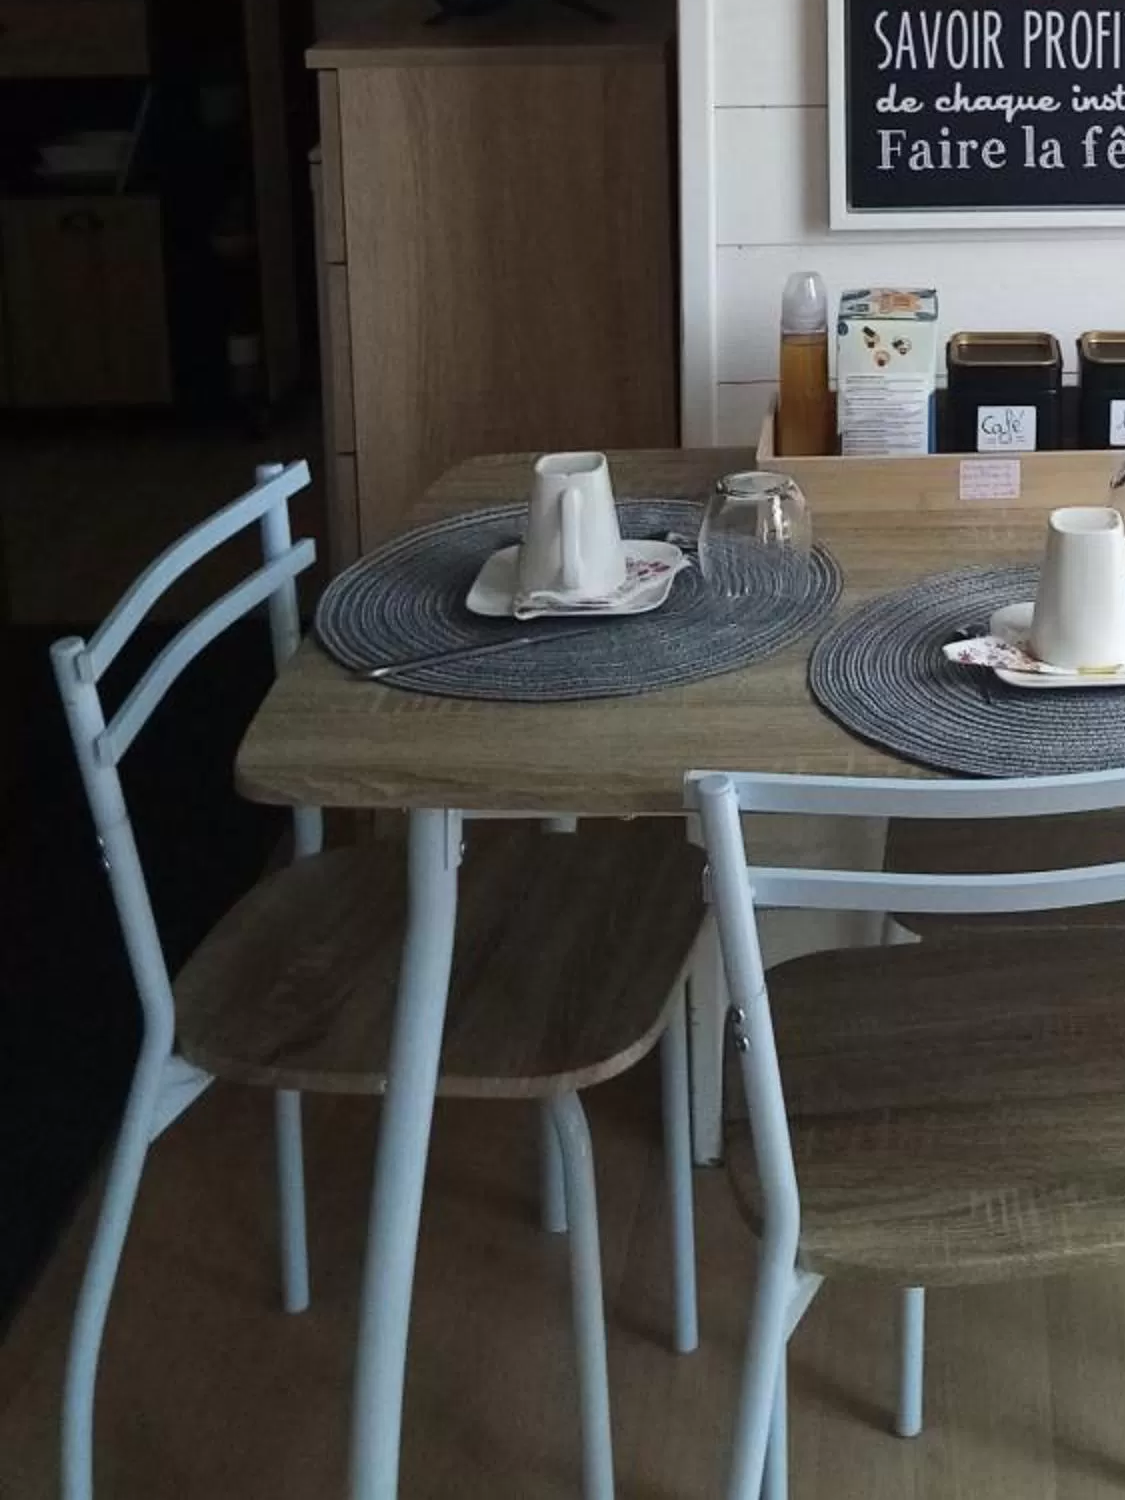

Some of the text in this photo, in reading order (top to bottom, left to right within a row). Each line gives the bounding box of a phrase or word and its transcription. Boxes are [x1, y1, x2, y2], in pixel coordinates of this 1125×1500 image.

[875, 10, 1004, 69] SAVOIR
[876, 84, 924, 112] de
[935, 82, 1061, 122] chaque
[878, 127, 1006, 170] Faire
[1022, 126, 1064, 168] la
